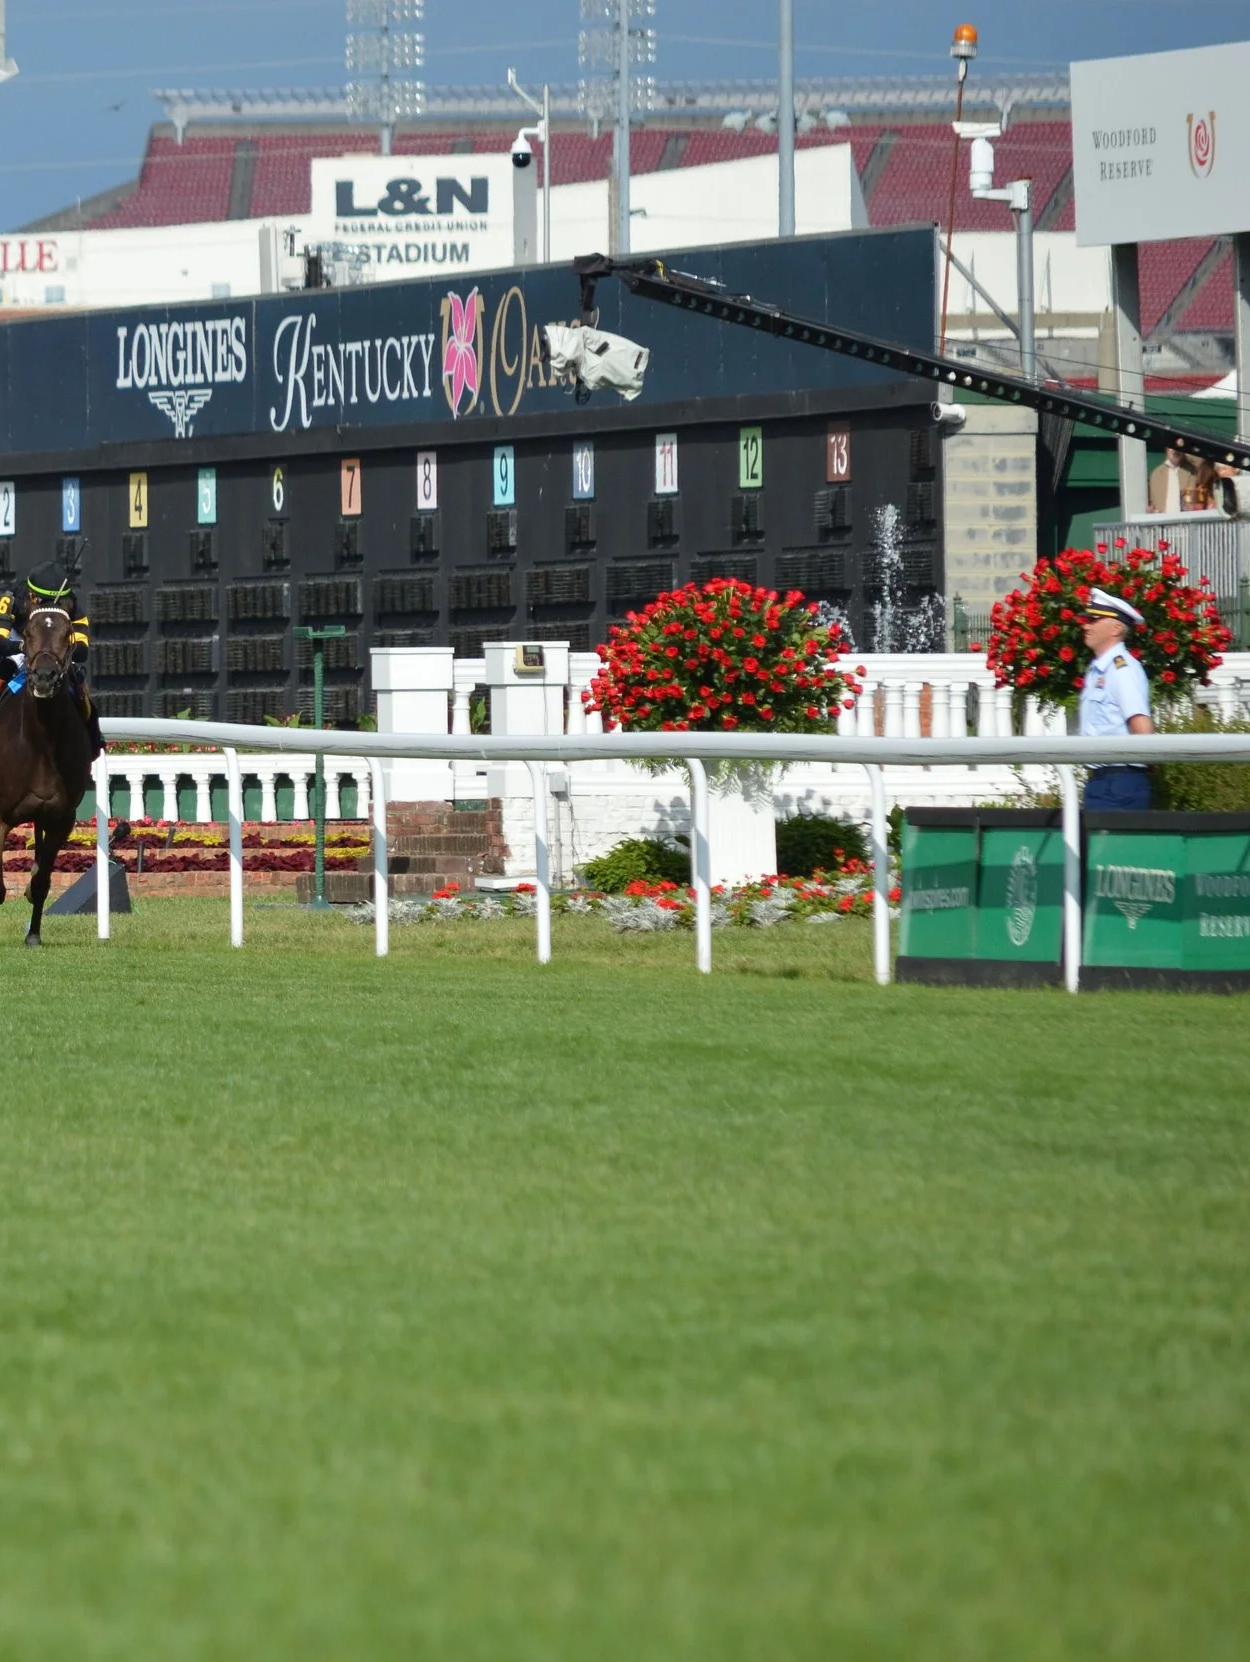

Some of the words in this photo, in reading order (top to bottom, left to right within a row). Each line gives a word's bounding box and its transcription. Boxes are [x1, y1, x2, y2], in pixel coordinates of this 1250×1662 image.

[1092, 127, 1157, 150] WOODFORD
[1100, 159, 1153, 181] RESERVE
[335, 175, 489, 217] L&N
[446, 220, 487, 232] UNION
[355, 242, 470, 264] STADIUM
[116, 316, 247, 389] LONGINES
[270, 312, 435, 432] KENTUCKY
[3, 487, 10, 528] 2
[67, 483, 76, 525] 3
[134, 479, 143, 521] 4
[201, 473, 212, 514] 5
[272, 467, 284, 512] 6
[346, 465, 356, 509] 7
[423, 458, 432, 501] 8
[499, 452, 509, 496] 9
[575, 446, 591, 493] 10
[660, 441, 676, 486] 11
[743, 435, 759, 481] 12
[831, 432, 848, 475] 13
